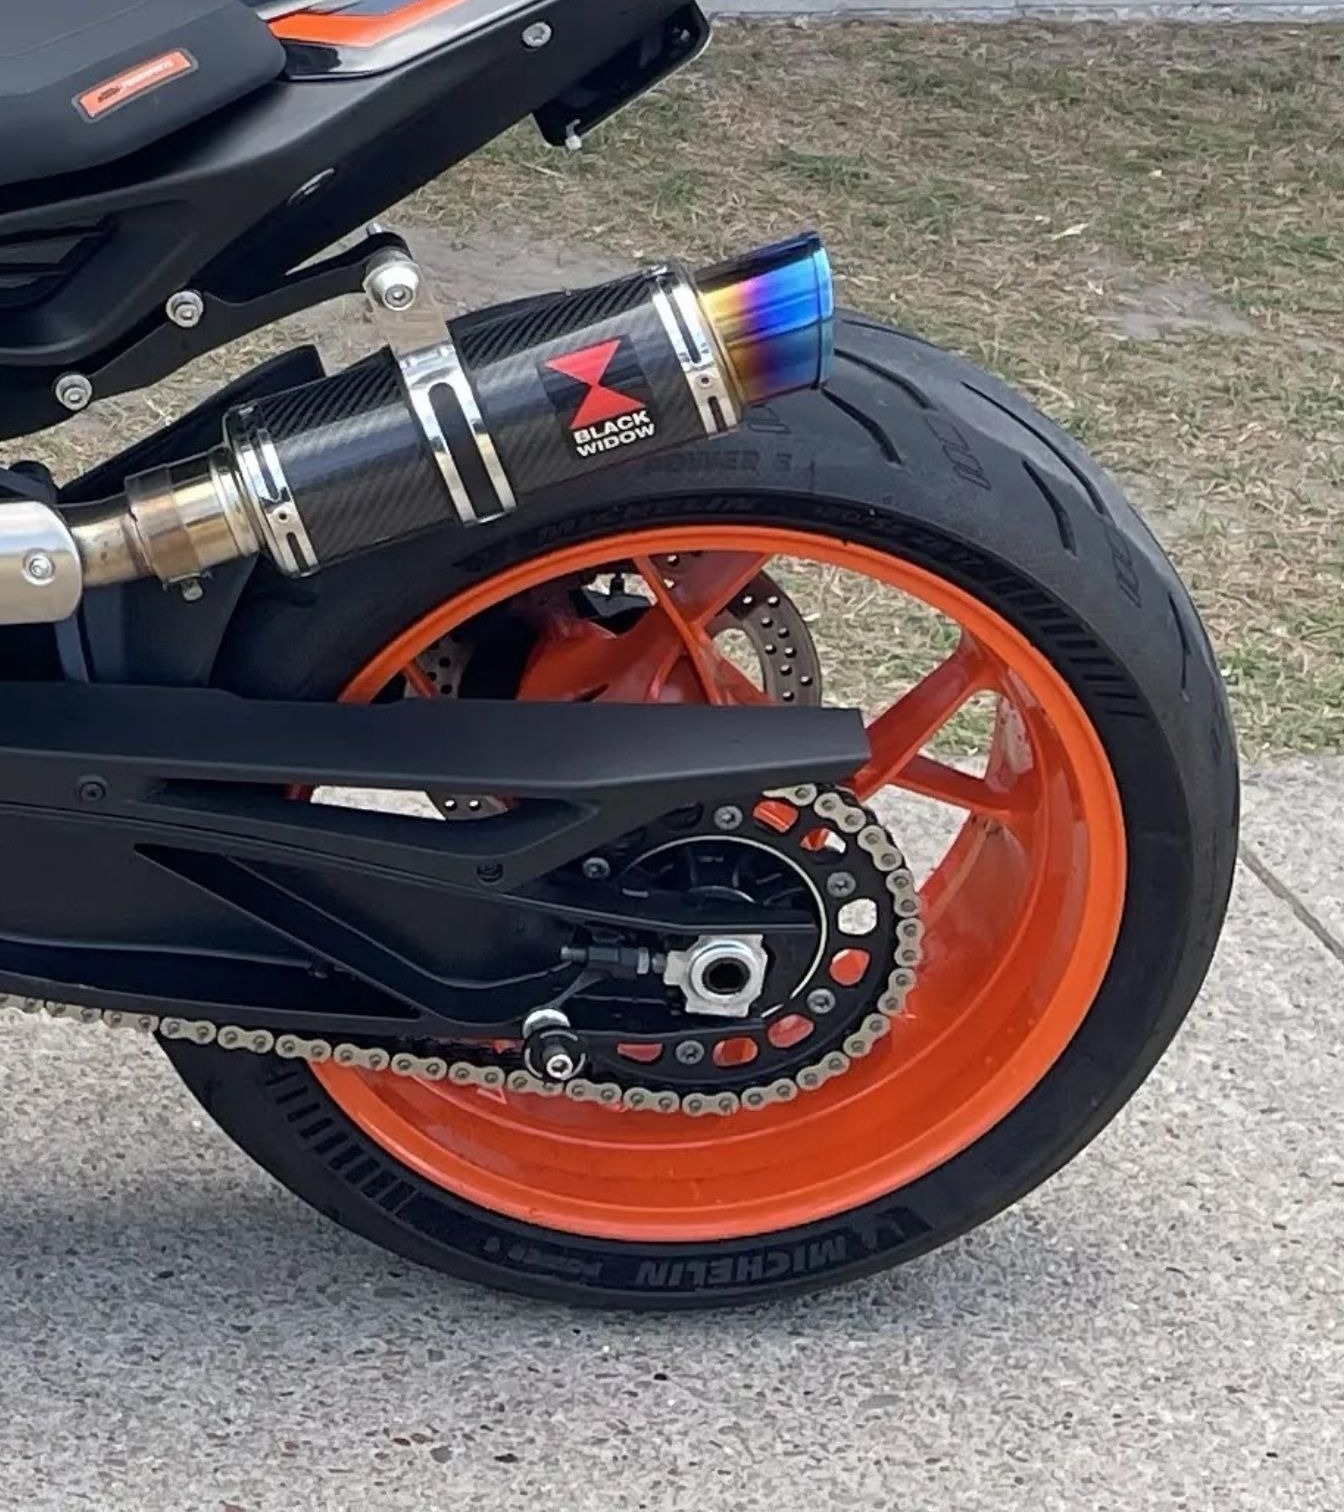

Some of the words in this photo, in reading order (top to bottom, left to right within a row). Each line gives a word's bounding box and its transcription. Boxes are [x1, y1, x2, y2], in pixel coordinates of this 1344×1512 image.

[573, 410, 651, 444] BLACK
[576, 423, 655, 457] WIDOW
[635, 1235, 849, 1288] MICHELIN
